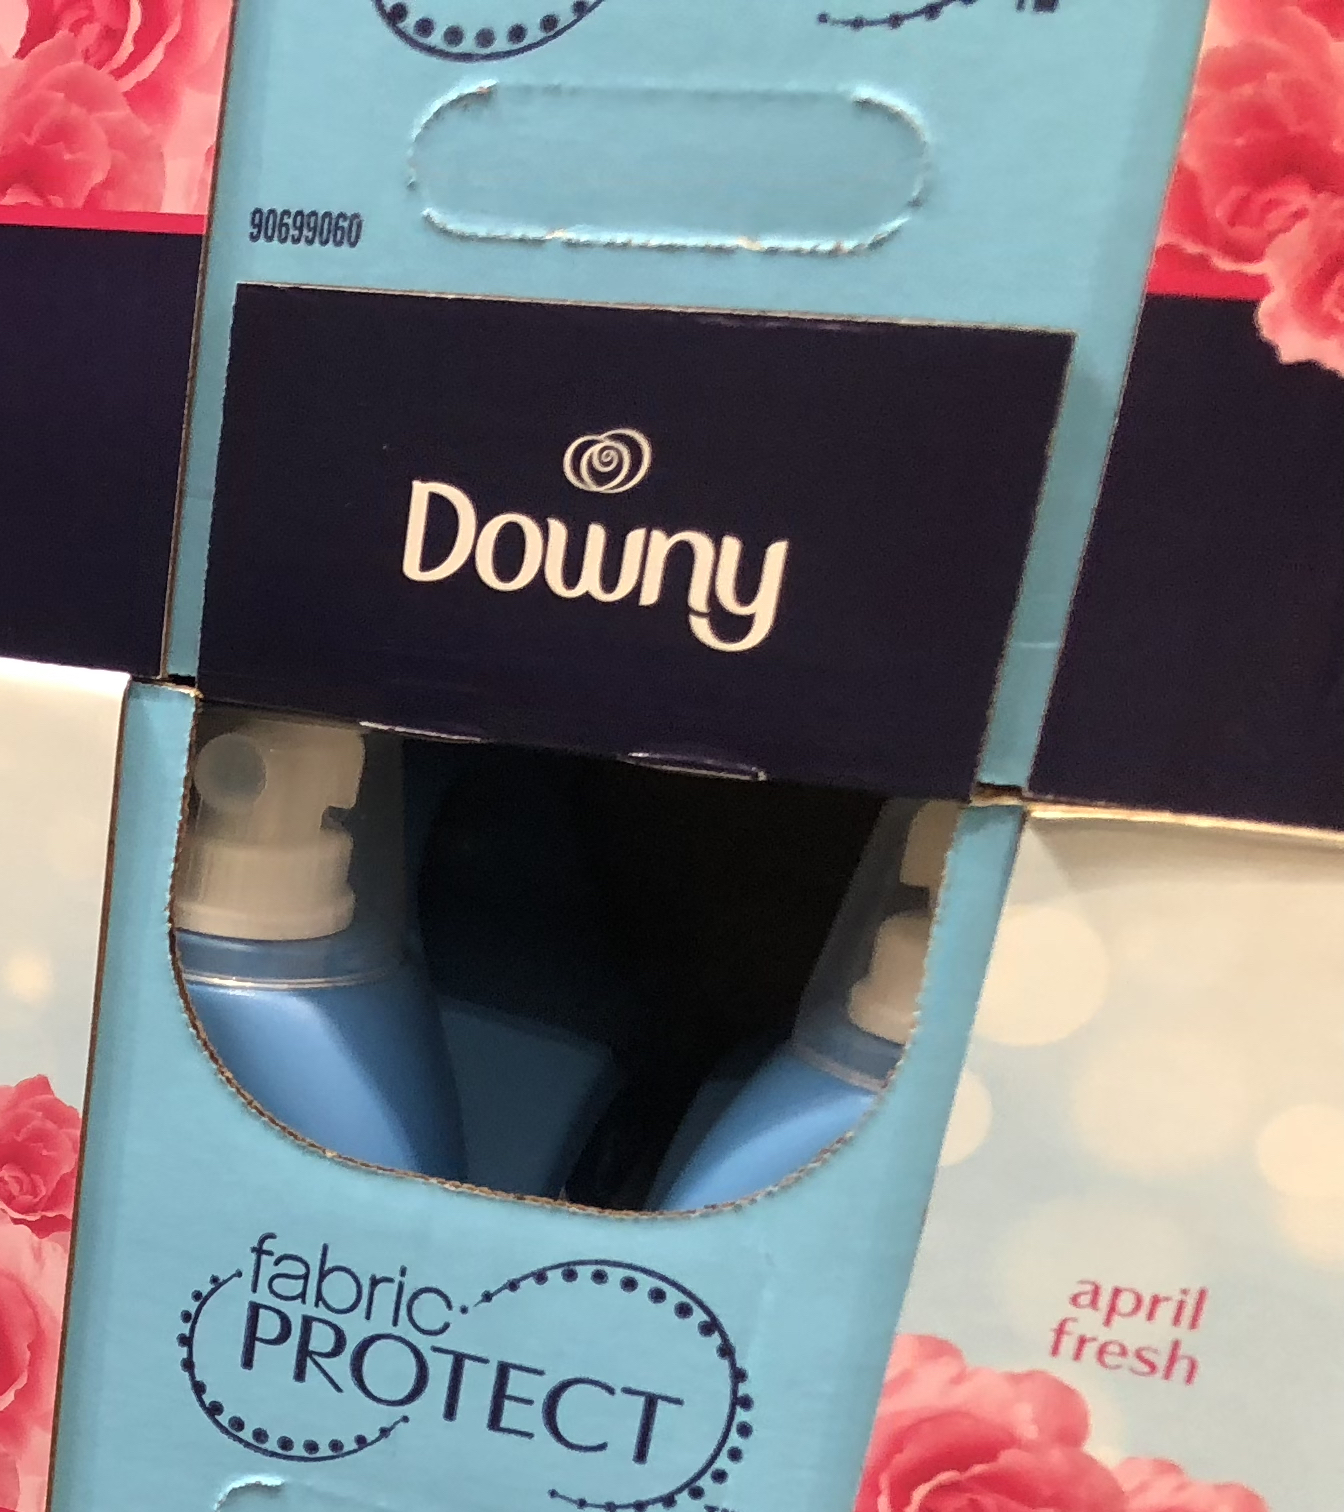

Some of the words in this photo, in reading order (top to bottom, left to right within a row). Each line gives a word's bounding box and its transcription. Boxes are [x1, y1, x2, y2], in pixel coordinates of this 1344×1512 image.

[248, 207, 363, 249] 90699060
[401, 478, 790, 652] Downy
[248, 1231, 454, 1337] fabric
[1068, 1278, 1209, 1331] april
[239, 1299, 685, 1465] PROTECT
[1049, 1316, 1200, 1387] fresh
